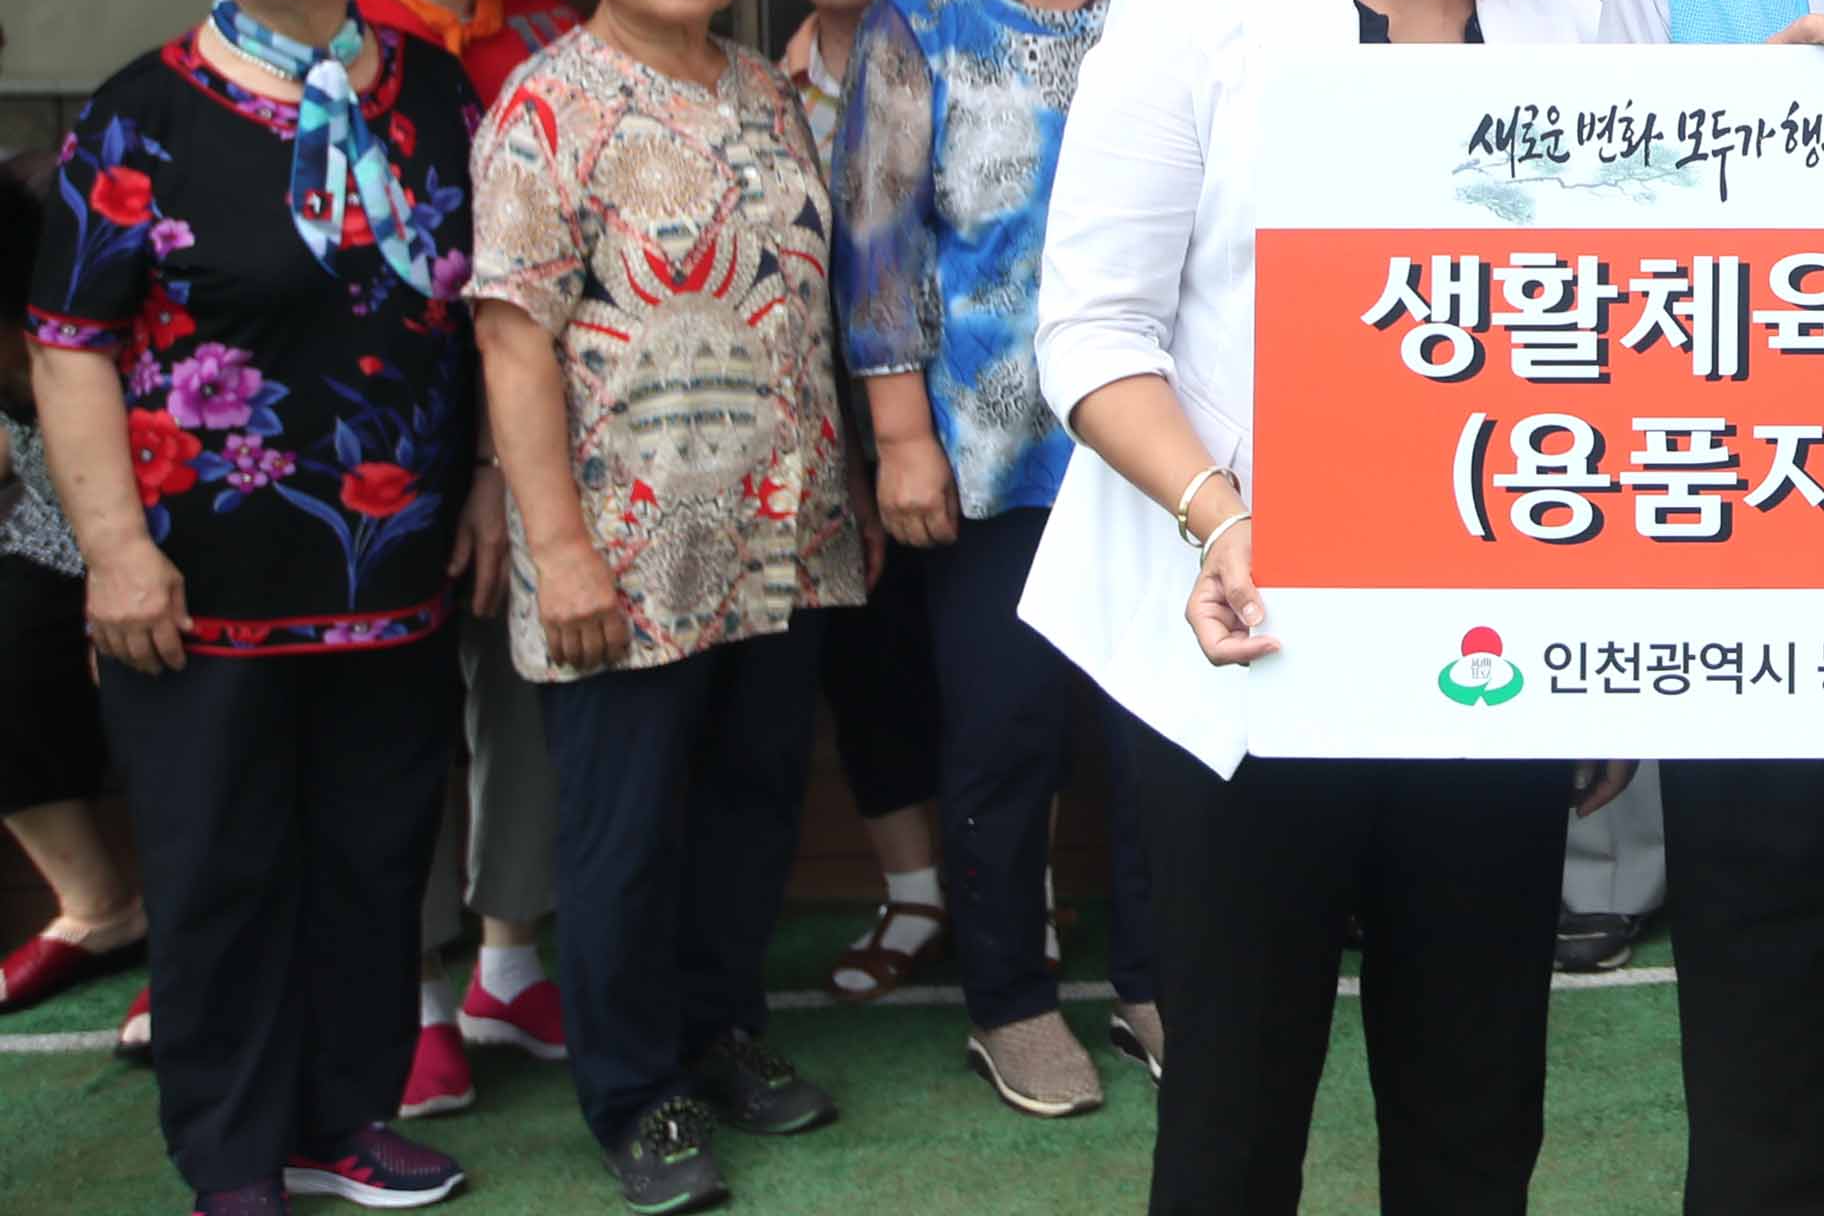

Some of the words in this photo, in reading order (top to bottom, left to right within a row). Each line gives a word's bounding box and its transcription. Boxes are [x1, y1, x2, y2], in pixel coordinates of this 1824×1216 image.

[1468, 104, 1571, 178] 새로운
[1576, 99, 1664, 167] 변화
[1675, 108, 1776, 203] 모두가
[1544, 641, 1796, 696] 인천광역시
